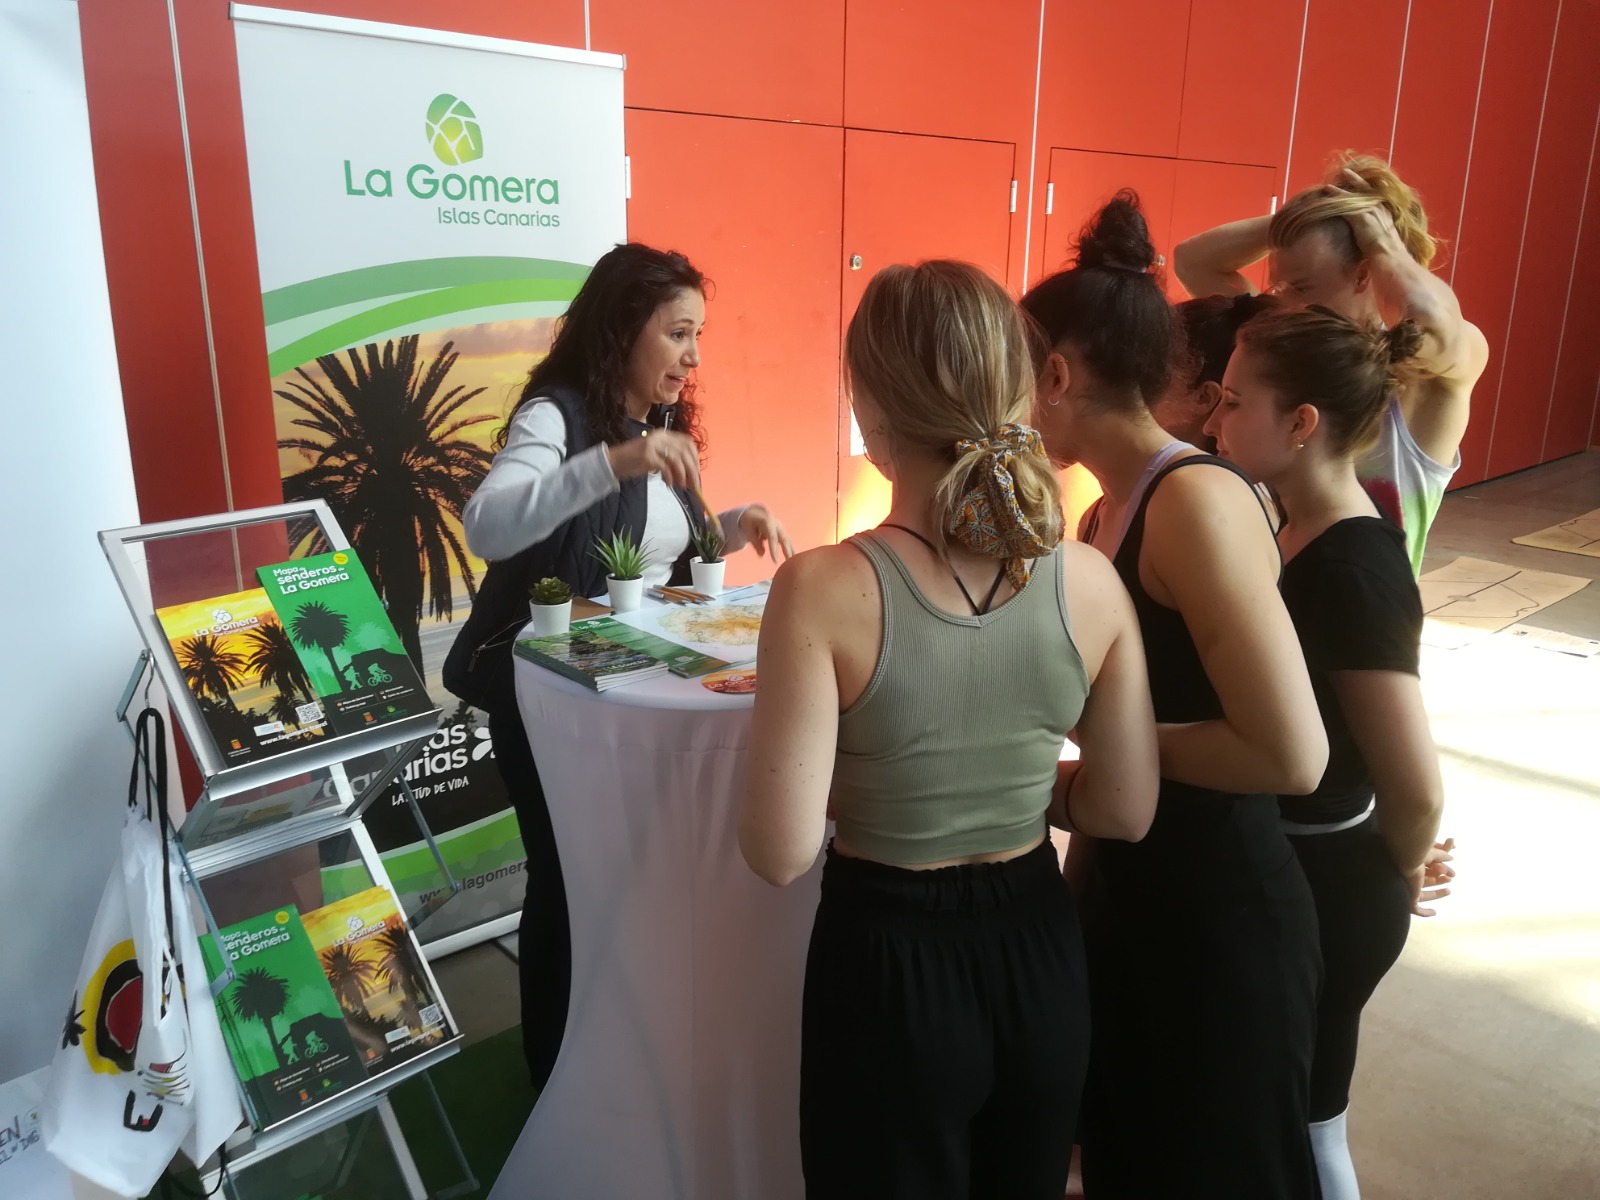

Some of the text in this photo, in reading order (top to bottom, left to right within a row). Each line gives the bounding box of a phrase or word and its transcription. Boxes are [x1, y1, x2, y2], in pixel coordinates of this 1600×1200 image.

[344, 159, 560, 205] La Gomera
[437, 206, 561, 228] Islas Canarias
[272, 566, 299, 577] Mapa
[276, 565, 338, 585] senderos
[279, 572, 350, 595] La Gomera
[193, 616, 259, 637] La Gomera
[391, 775, 470, 807] LATTUD DE VIDA
[241, 932, 291, 956] Gomera
